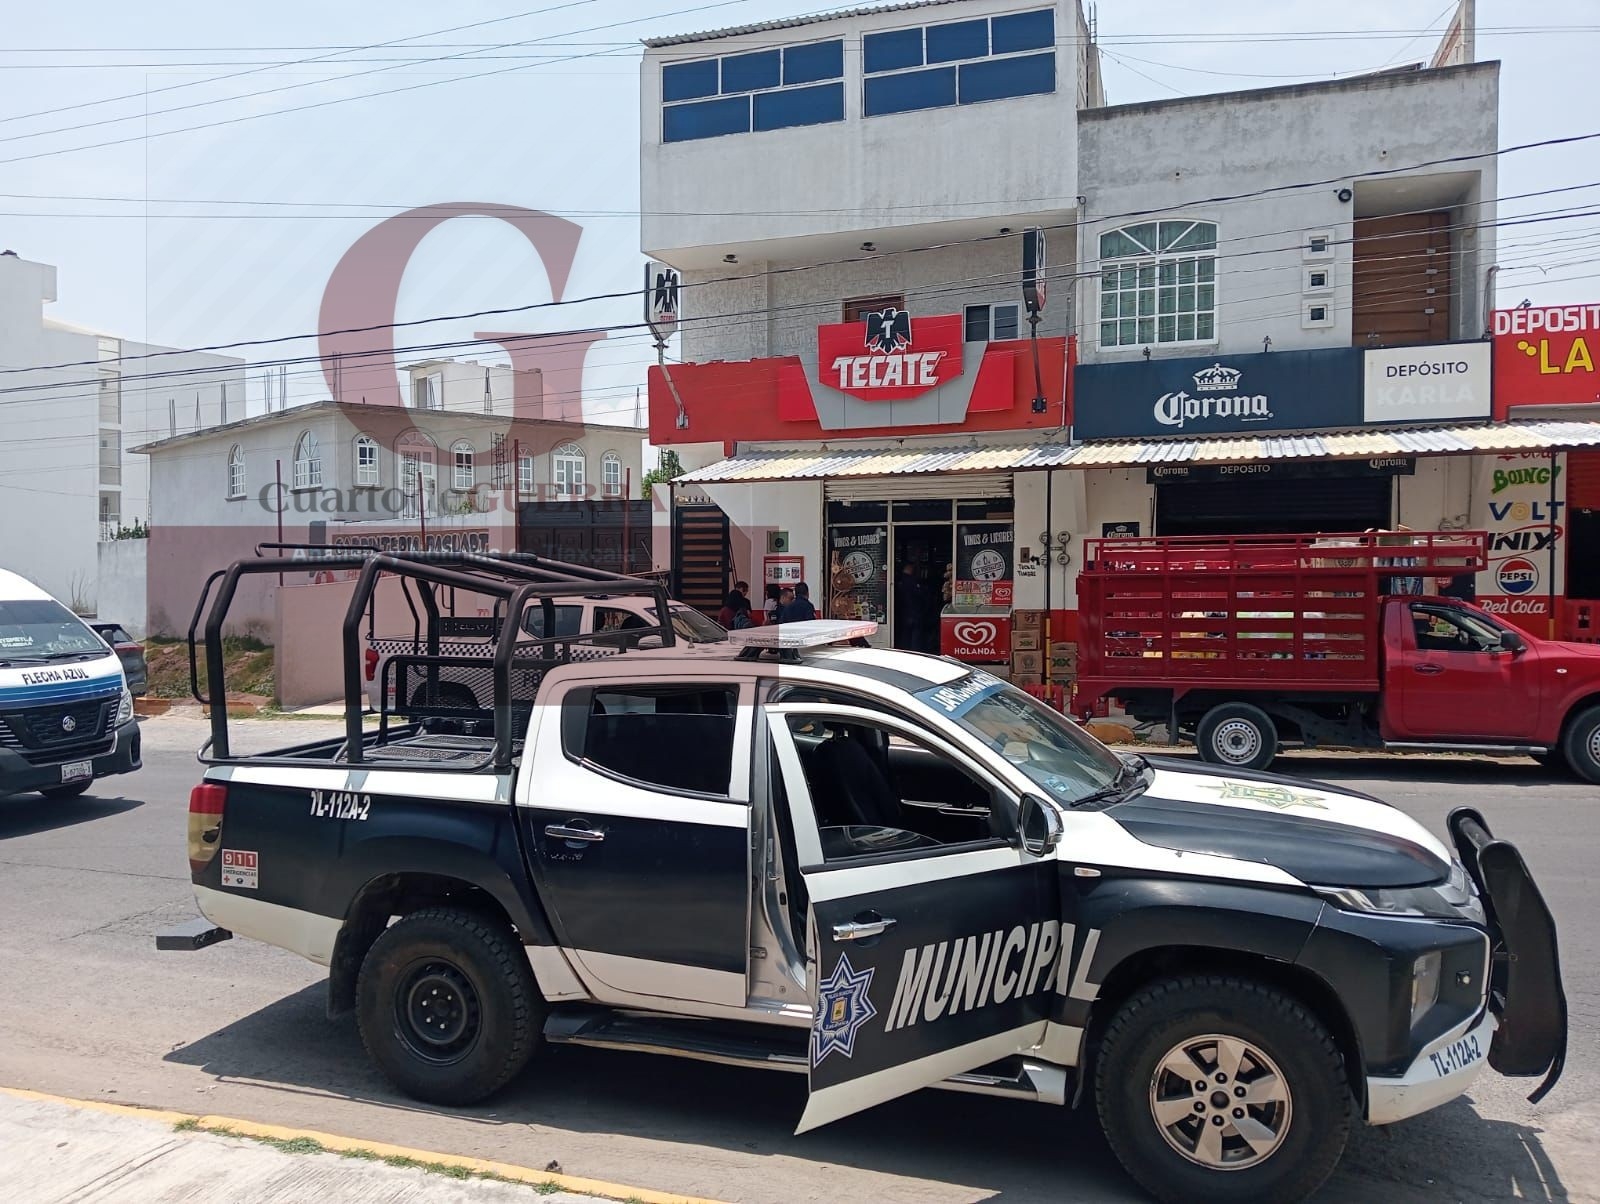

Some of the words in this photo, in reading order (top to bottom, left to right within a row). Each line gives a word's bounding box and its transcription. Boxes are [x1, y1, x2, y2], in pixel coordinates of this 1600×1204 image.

[1540, 338, 1594, 374] LA
[832, 352, 941, 389] TECATE
[1386, 361, 1469, 378] DEPÓSITO
[1376, 382, 1475, 407] KARLA
[1153, 390, 1270, 428] Corona
[1154, 466, 1189, 478] Corona
[1220, 464, 1270, 474] DEPOSITO
[1369, 458, 1408, 469] Corona
[1488, 501, 1565, 520] VOLT
[963, 534, 981, 546] VINOS
[990, 531, 1014, 544] LICORES
[1500, 572, 1532, 581] PEPSI
[1480, 598, 1509, 614] Red
[1511, 599, 1547, 614] Cola
[21, 671, 63, 685] FLECHA
[63, 668, 89, 681] AZUL
[310, 790, 371, 821] TL-112A-2
[224, 853, 255, 867] 911
[223, 869, 257, 878] EMERGENCIAS
[885, 919, 1102, 1033] MUNICIPAL
[1429, 1034, 1482, 1077] TL-112A-2
